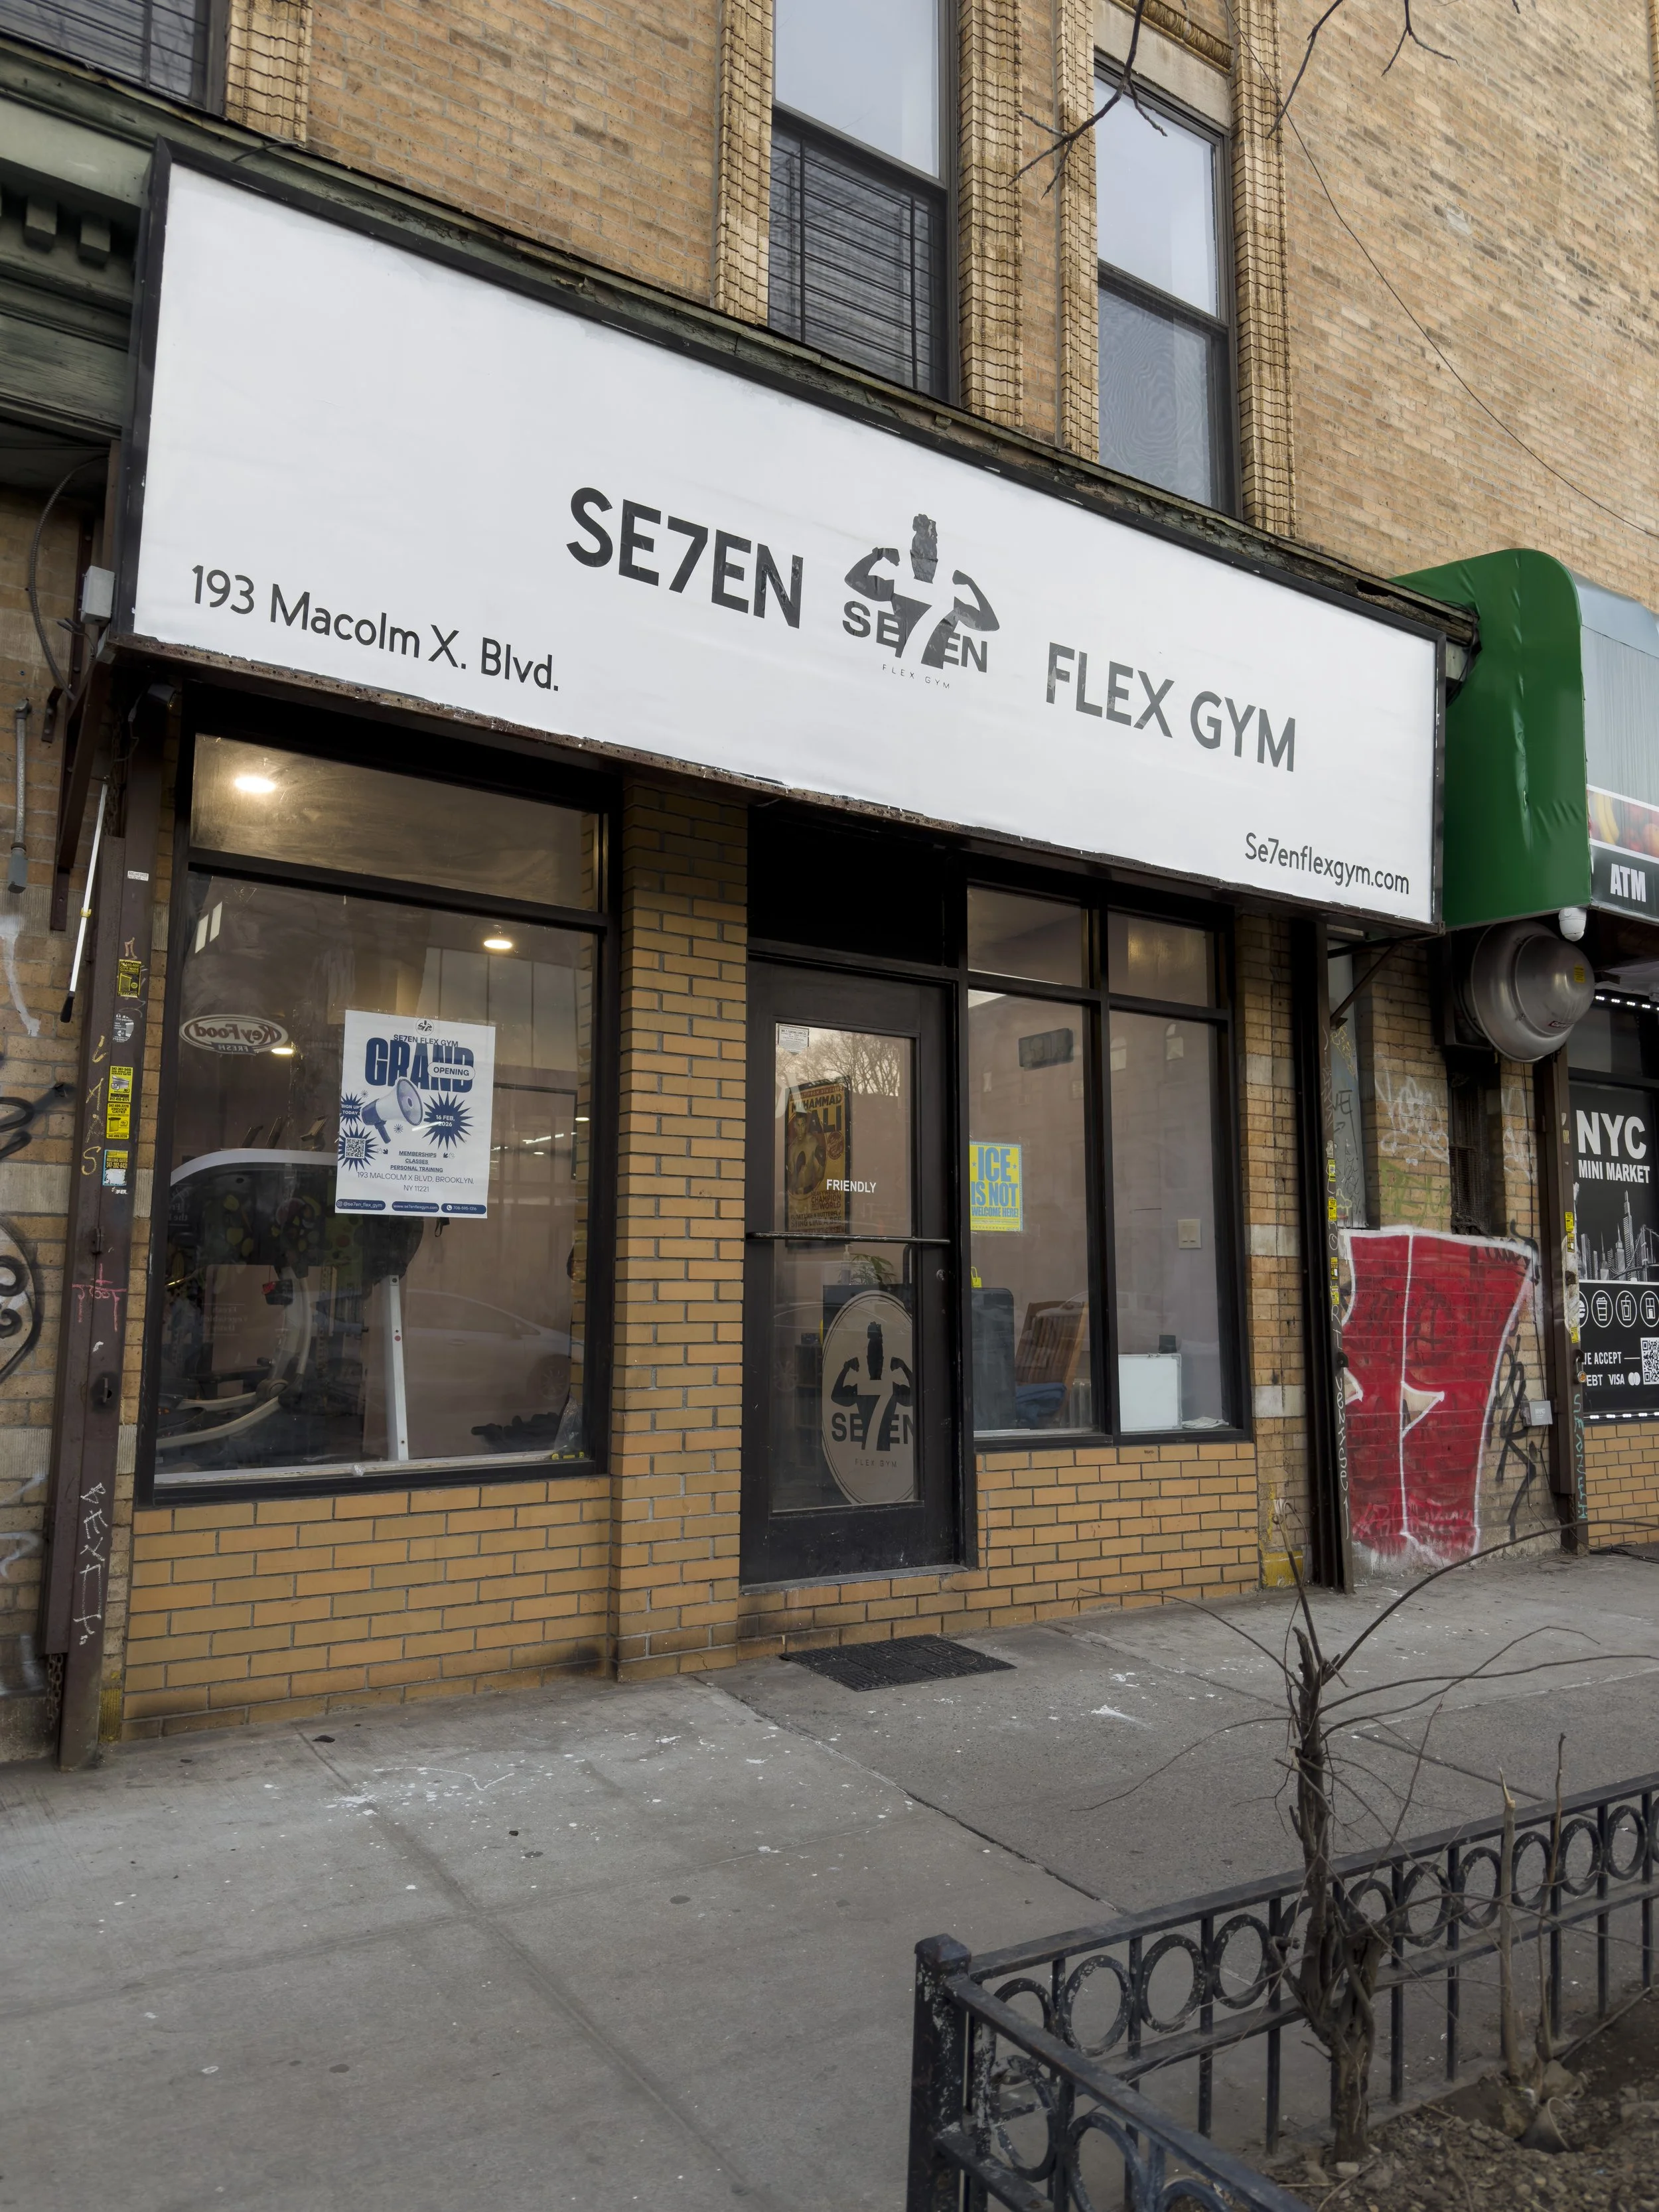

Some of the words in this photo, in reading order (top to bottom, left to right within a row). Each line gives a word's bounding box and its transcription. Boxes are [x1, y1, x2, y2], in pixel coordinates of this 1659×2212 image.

[567, 487, 804, 628] SE7EN
[192, 564, 254, 615] 193
[269, 583, 420, 658] Macolm
[428, 624, 467, 669] X.
[480, 636, 559, 691] Blvd.
[882, 664, 915, 679] FLEX
[924, 676, 950, 690] GYM
[1046, 642, 1175, 738] FLEX
[1190, 690, 1296, 772] GYM
[1245, 832, 1409, 895] Se7enflexgym.com
[1610, 863, 1646, 903] ATM
[394, 1034, 418, 1043] SE7EN
[365, 1037, 474, 1093] GRAND
[433, 1067, 470, 1076] OPENING
[809, 1105, 842, 1134] ALI
[1576, 1110, 1647, 1159] NYC
[370, 1172, 407, 1181] MALCOLM
[977, 1146, 1012, 1182] ICE
[1578, 1159, 1603, 1179] MINI
[1606, 1162, 1650, 1183] MARKET
[826, 1179, 877, 1193] FRIENDLY
[971, 1181, 986, 1206] IS
[988, 1181, 1019, 1207] NOT
[811, 1195, 841, 1204] CHAMPION
[820, 1201, 841, 1210] WORLD
[972, 1207, 1001, 1217] WELCOME
[1594, 1351, 1622, 1364] ACCEPT
[1607, 1373, 1625, 1386] VISA
